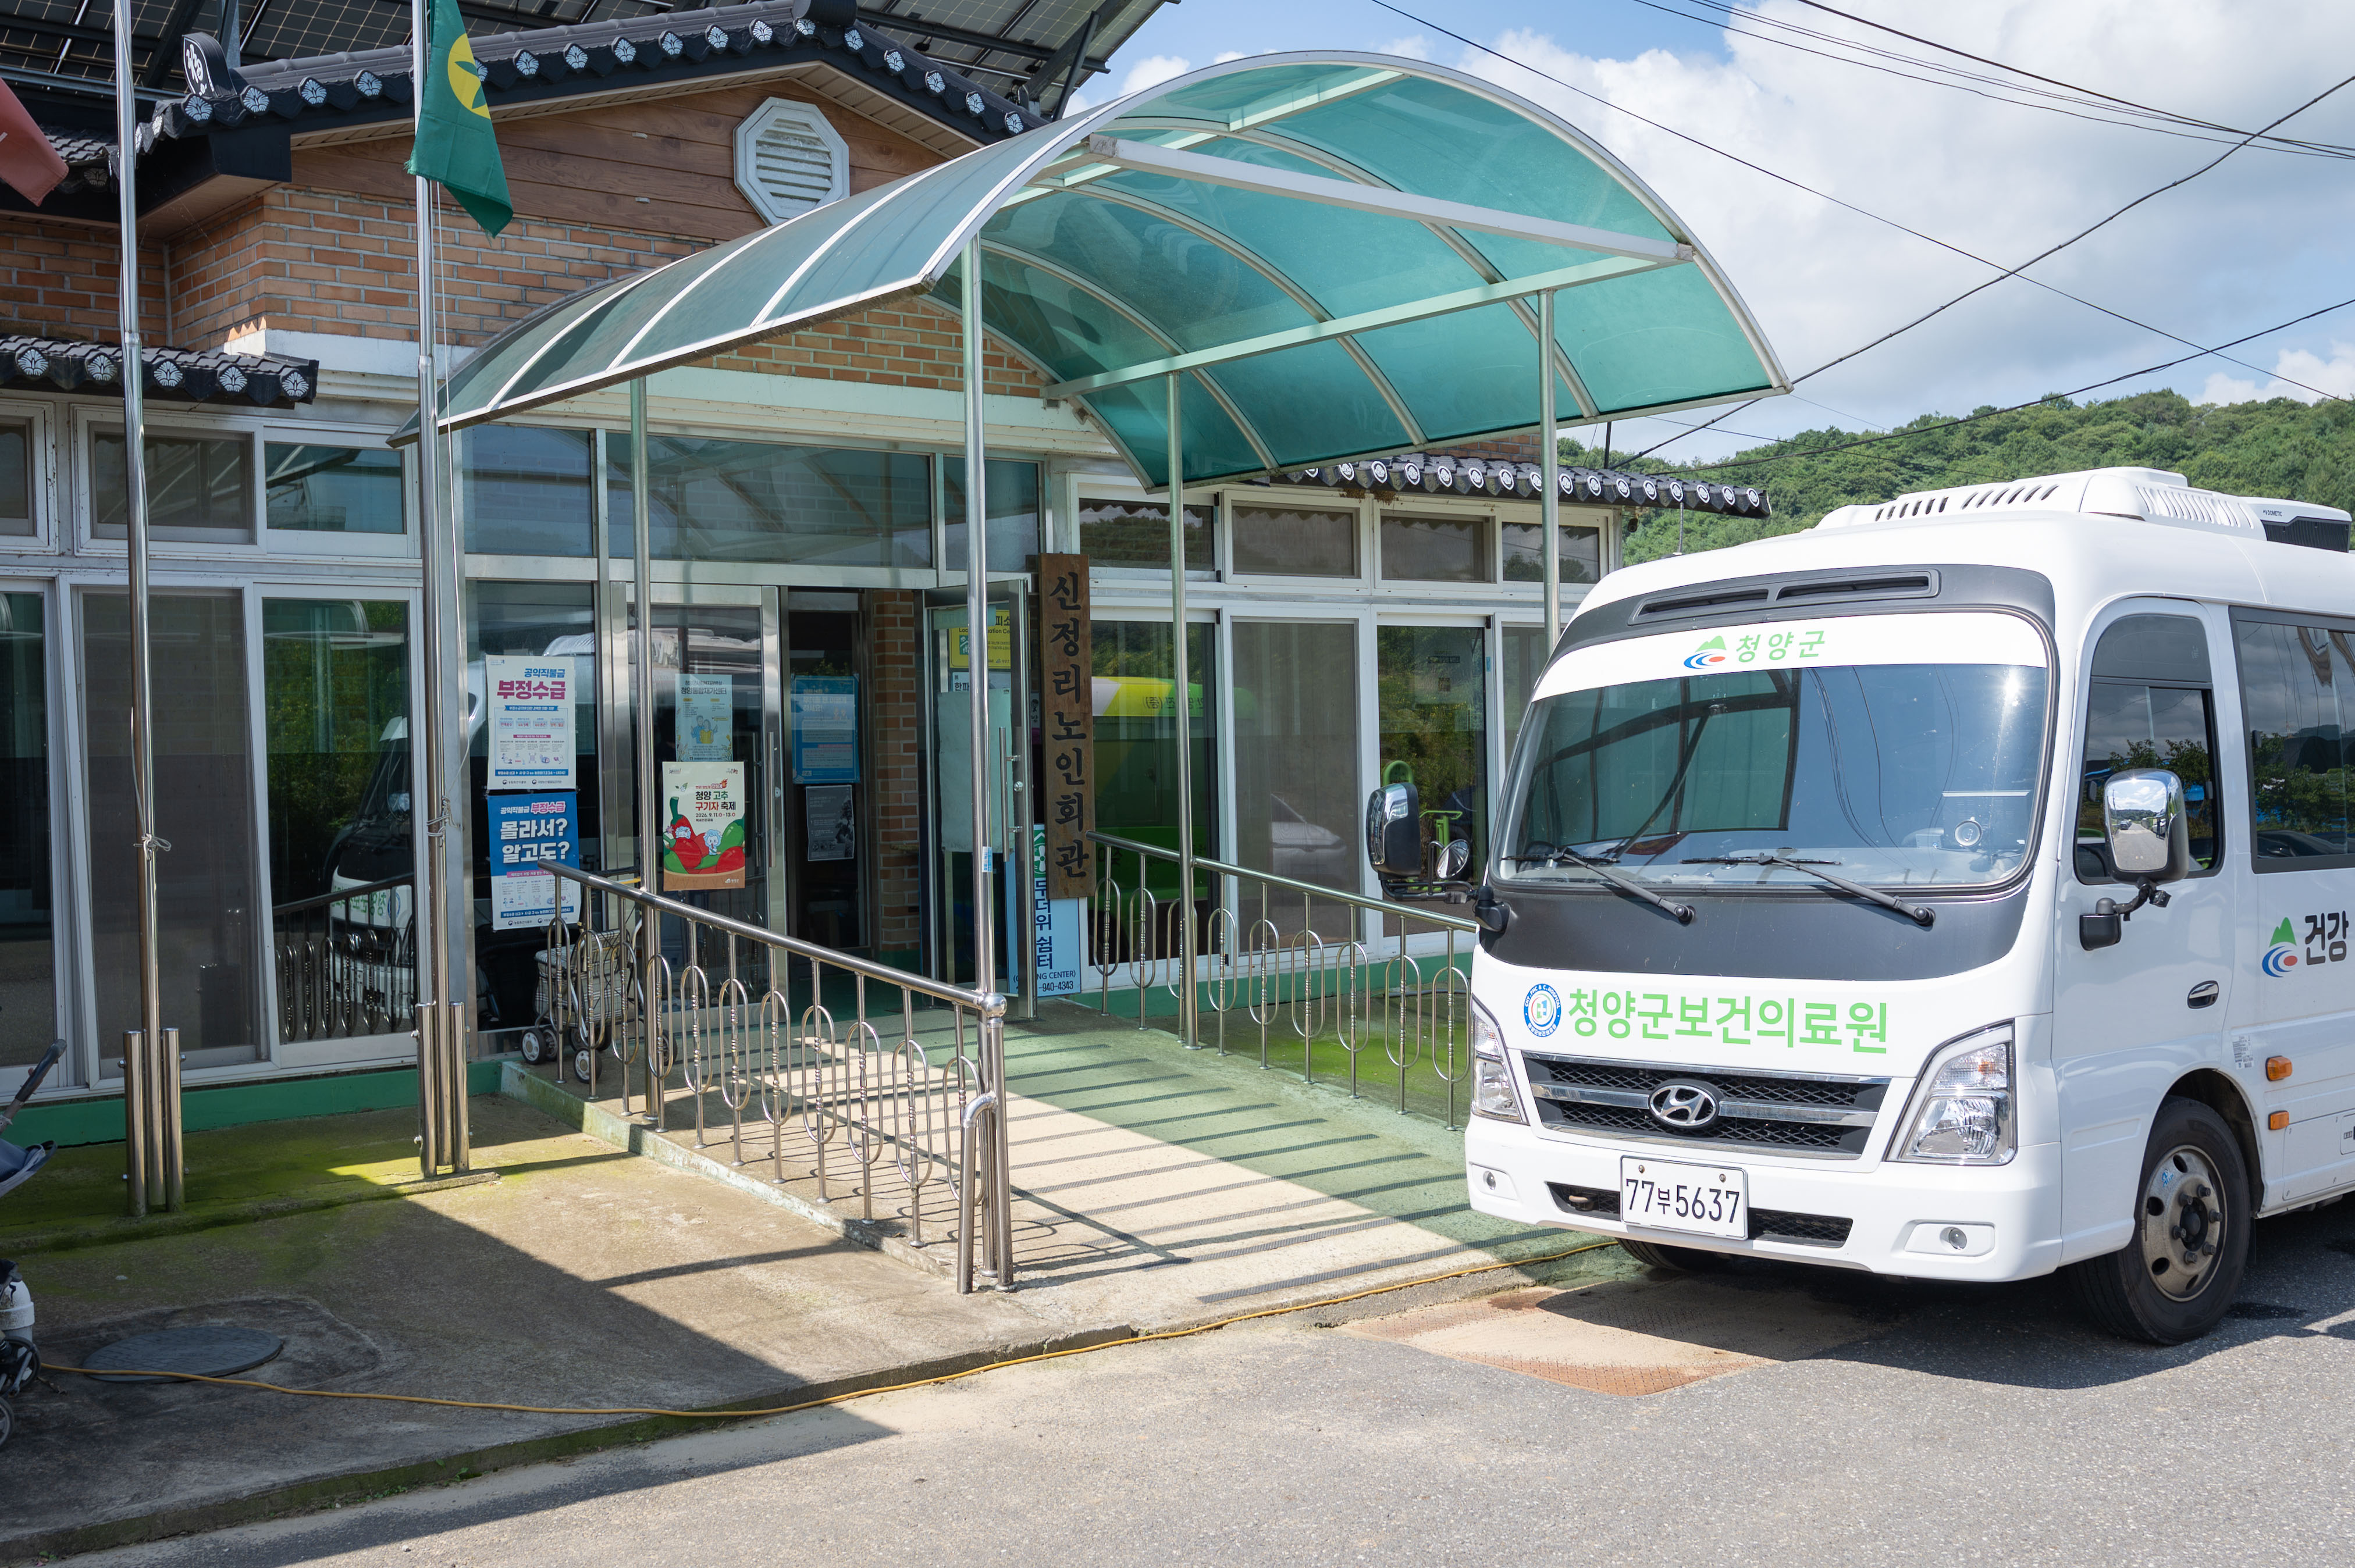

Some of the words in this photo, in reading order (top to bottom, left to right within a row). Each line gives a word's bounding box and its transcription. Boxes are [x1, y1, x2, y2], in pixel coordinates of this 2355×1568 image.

[1736, 630, 1825, 662] 청양군
[524, 668, 565, 678] 공익직불금
[497, 680, 566, 700] 부정수급
[1049, 572, 1089, 878] 신정리노인회관
[695, 801, 719, 811] 구기자
[721, 801, 736, 811] 축제
[696, 791, 711, 800] 청양
[713, 791, 728, 800] 고추
[500, 806, 529, 814] 공익직불금
[531, 801, 565, 814] 부정수급
[500, 818, 568, 840] 몰라서?
[502, 841, 570, 864] 알고도?
[2304, 910, 2349, 965] 건강
[1036, 935, 1053, 970] 쉼터
[1048, 970, 1076, 979] CENTER)
[1568, 988, 1887, 1054] 청양군보건의료원
[1625, 1178, 1739, 1224] 77부5637
